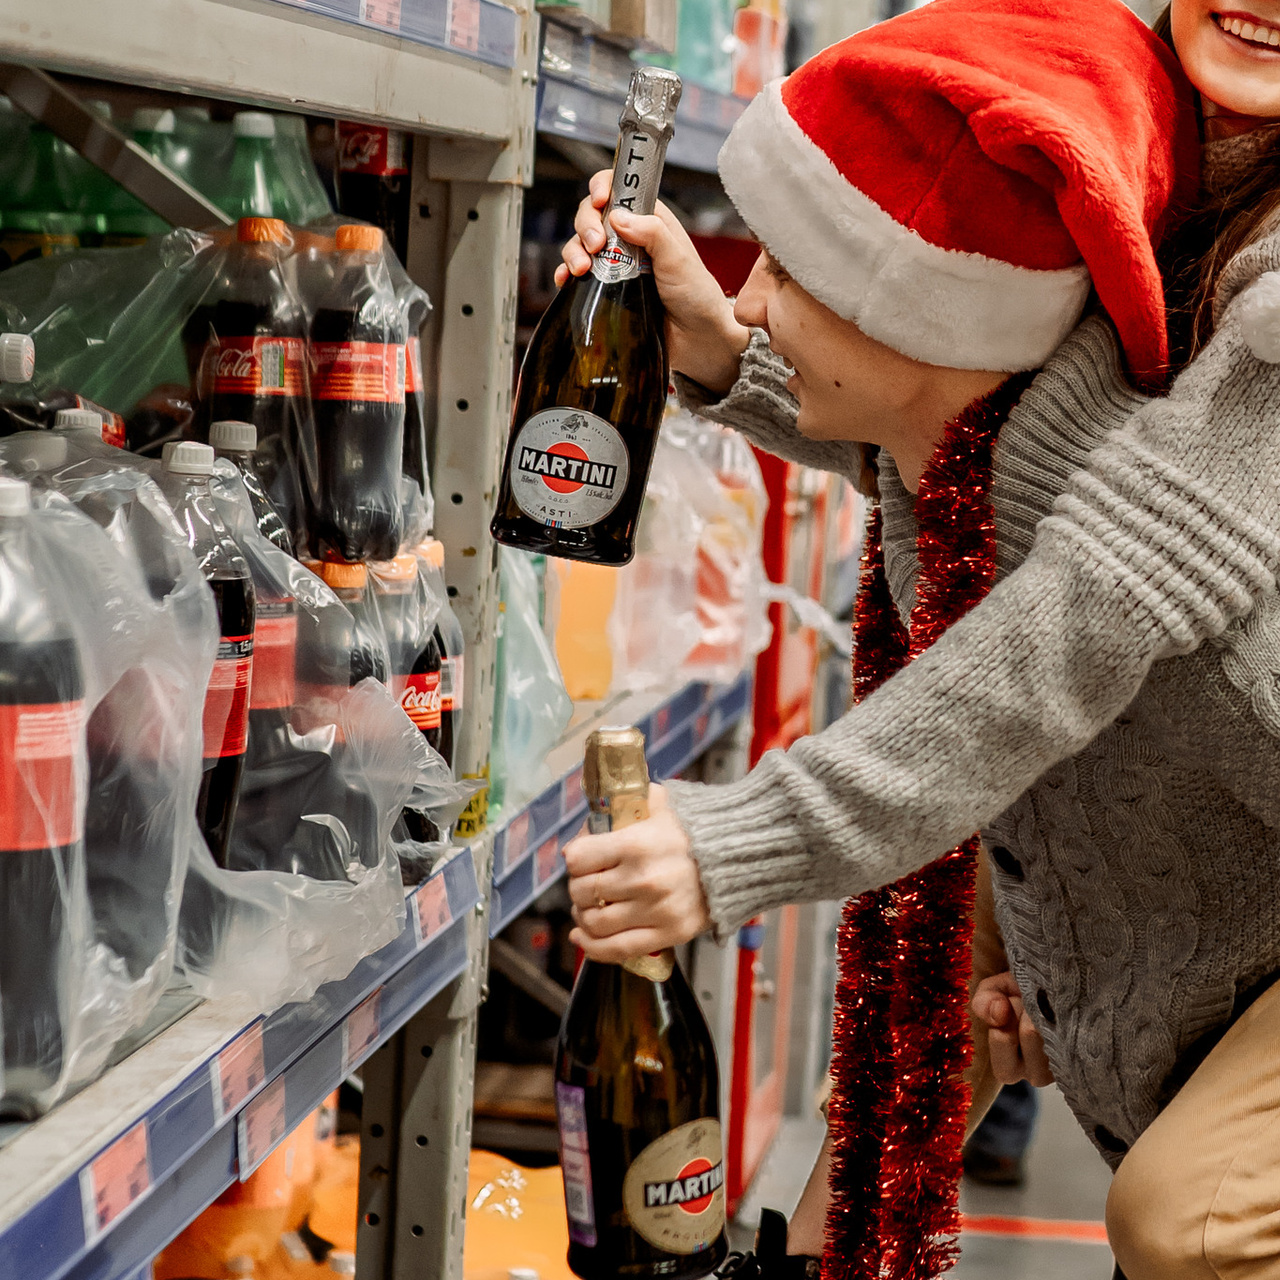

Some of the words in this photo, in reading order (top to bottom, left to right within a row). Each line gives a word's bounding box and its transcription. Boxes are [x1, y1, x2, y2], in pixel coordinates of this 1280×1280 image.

[618, 134, 648, 212] ASTI
[598, 249, 633, 266] MARTINI
[520, 449, 614, 486] MARTINI
[540, 505, 572, 518] ASTI
